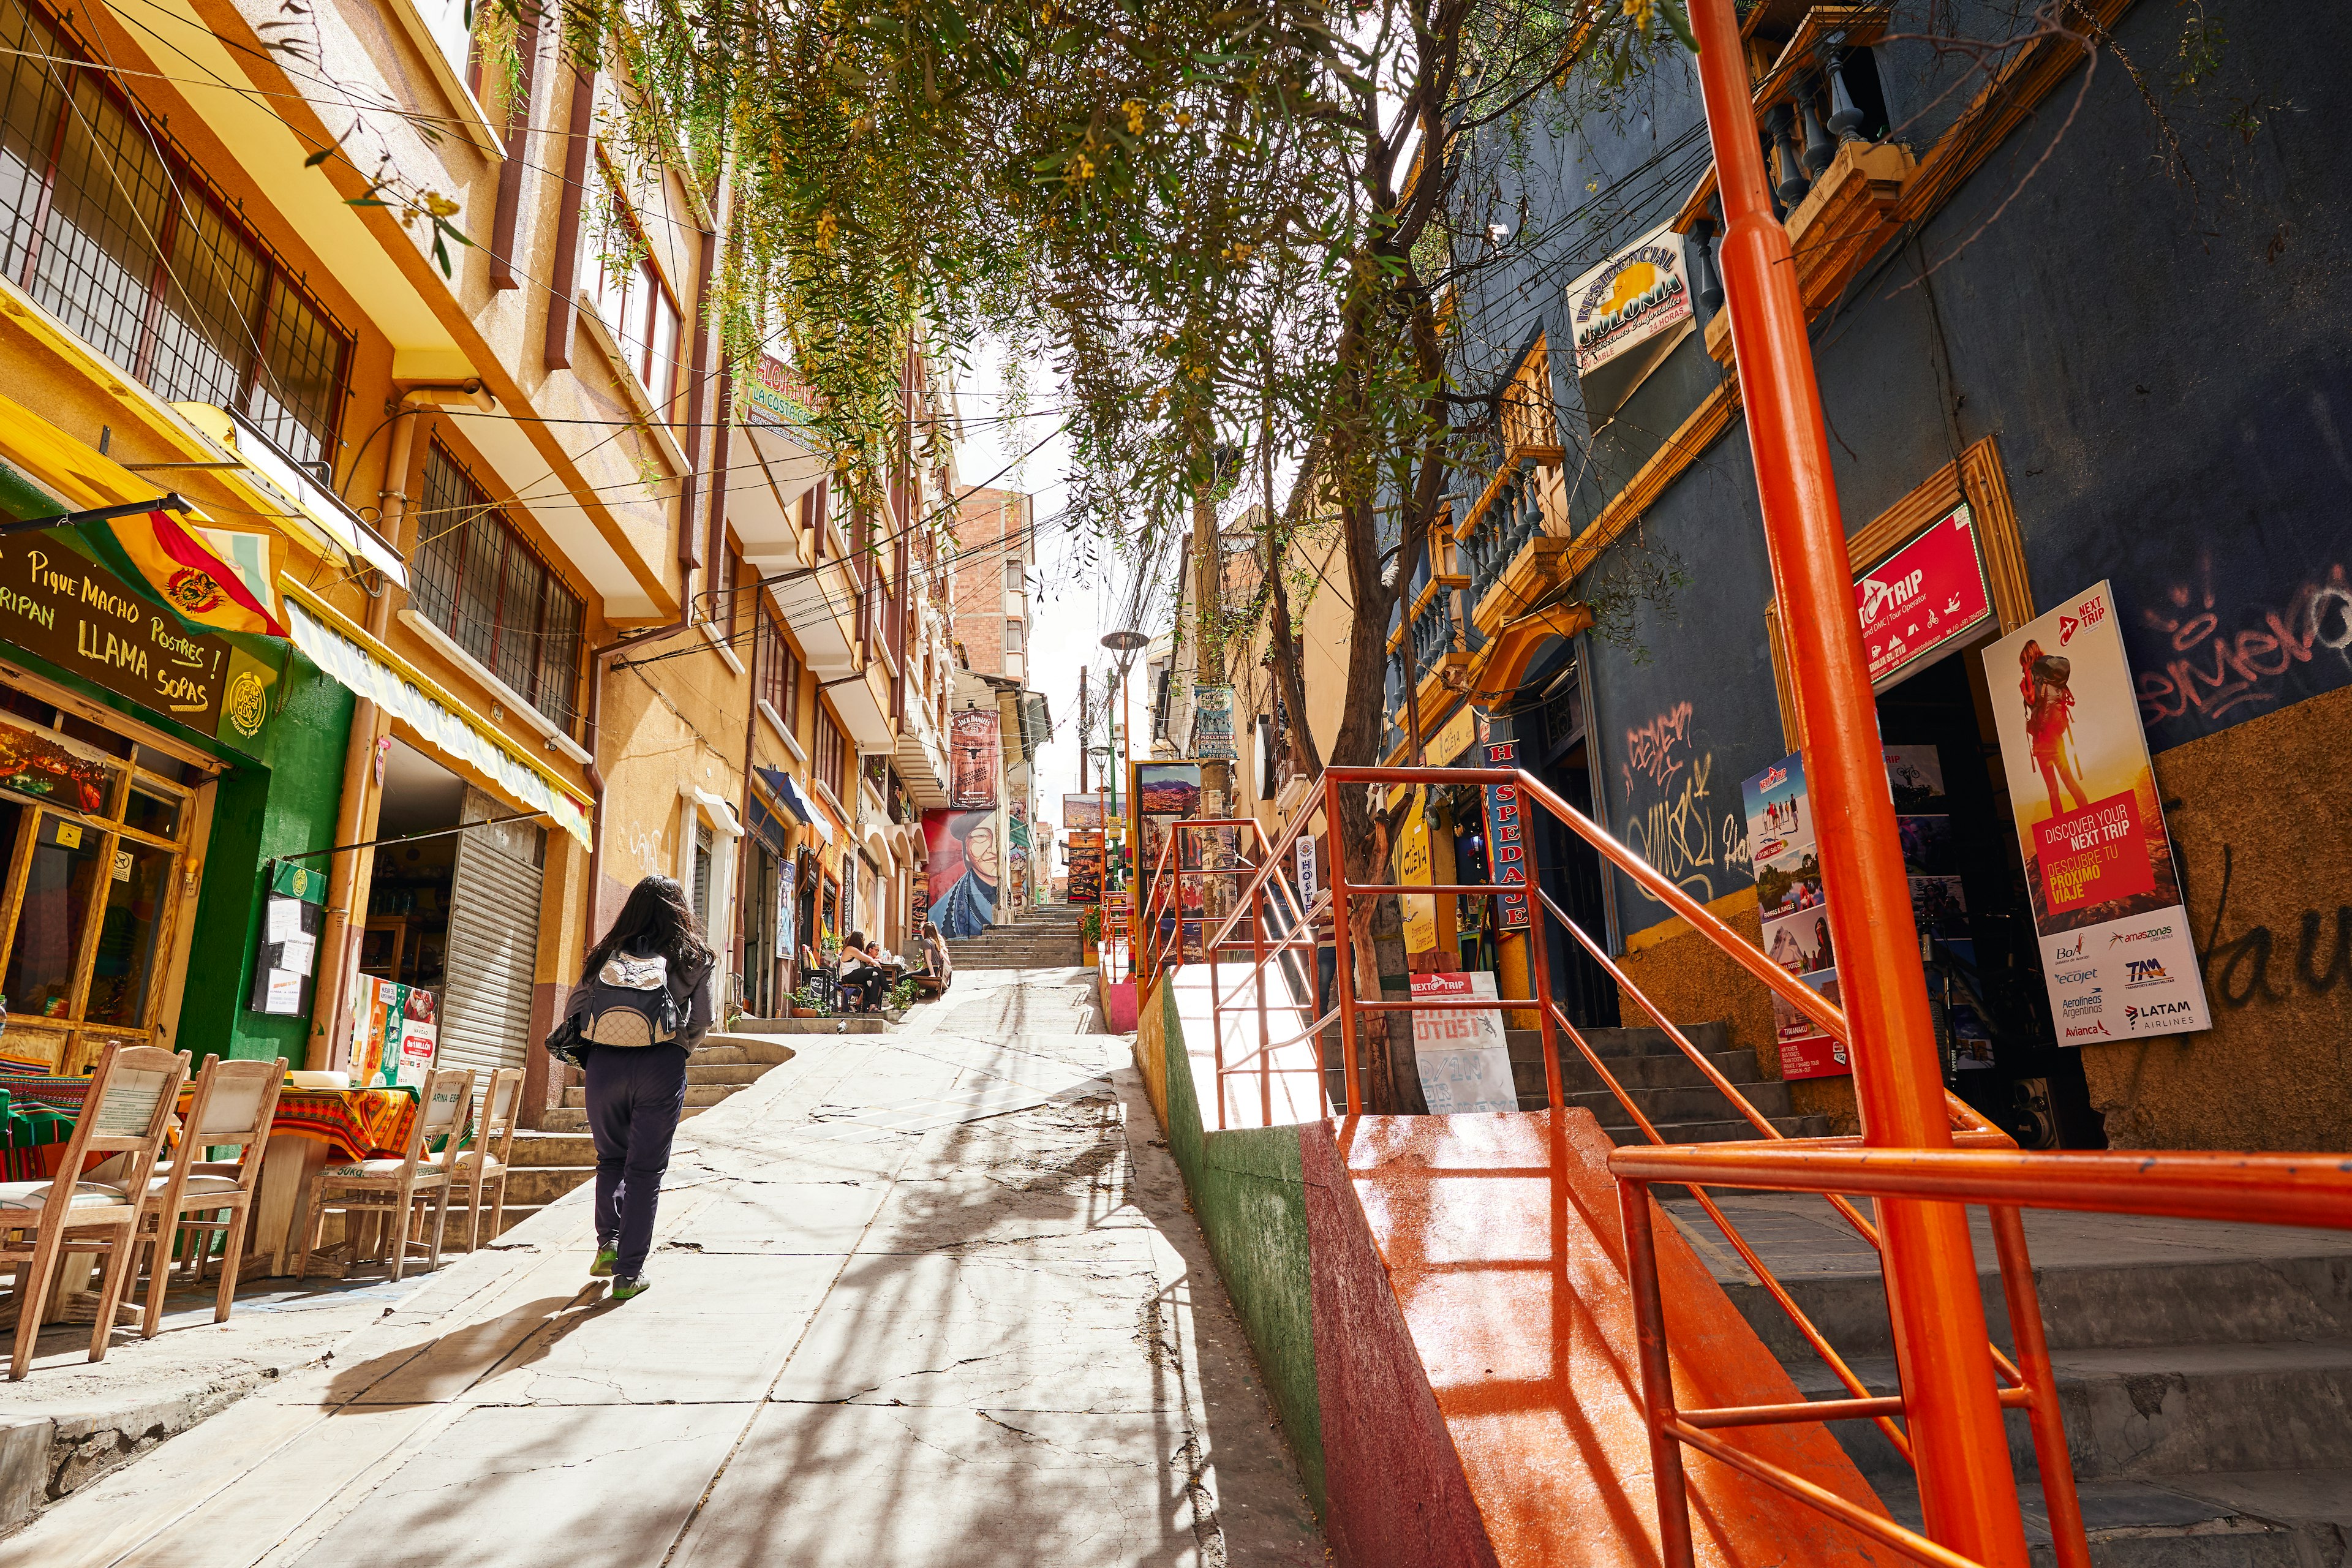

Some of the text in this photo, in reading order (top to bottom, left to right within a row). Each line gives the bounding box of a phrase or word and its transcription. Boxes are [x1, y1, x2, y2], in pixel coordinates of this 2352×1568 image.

[1577, 246, 1676, 322] RESIDENCIAL
[1579, 274, 1682, 347] COLONIA
[1649, 307, 1684, 333] 24 HORAS
[1593, 347, 1615, 365] CABLE
[753, 384, 796, 421] LA COSTA
[766, 410, 780, 423] HORAS
[81, 576, 140, 624] MACHO
[1884, 568, 1923, 611] TRIP
[1874, 593, 1927, 632] DMC Tour Operator
[2079, 595, 2101, 617] NEXT
[2081, 607, 2105, 628] TRIP
[77, 619, 148, 681] LLAMA
[151, 616, 205, 668] POSTRES
[1868, 657, 1887, 673] TARIJA
[1895, 643, 1906, 658] 210
[154, 669, 209, 712] SOPAS
[230, 715, 258, 739] bolivian food
[957, 717, 971, 727] JACK
[1444, 730, 1460, 753] CUEVA
[1759, 767, 1787, 790] NEXT TRIP
[1489, 744, 1529, 925] HSPEDAJE
[2045, 804, 2128, 844] DISCOVER YOUR
[2070, 820, 2130, 851] NEXT TRIP
[1404, 845, 1427, 876] CUEVA
[1758, 849, 1769, 859] UYUNI
[2048, 844, 2119, 878] DESCUBRE TU
[2049, 864, 2101, 891] PROXIMO
[2052, 883, 2085, 905] VIAJE
[1763, 909, 1777, 919] PAMPAS
[1781, 902, 1795, 913] JUNGLE
[2125, 926, 2172, 943] amaszonas
[2057, 944, 2081, 960] BoA
[2059, 968, 2098, 984] ecojet
[2125, 958, 2166, 982] TAM
[1411, 981, 1464, 991] NEXT TRIP
[2063, 995, 2101, 1009] Aerolíneas
[2063, 1005, 2103, 1019] Argentinas
[2141, 1001, 2191, 1017] LATAM
[1413, 1018, 1480, 1041] OTOSI
[1784, 1025, 1807, 1036] TIWANAKU
[2066, 1026, 2098, 1038] Avianca
[2144, 1016, 2194, 1029] AIRLINES
[1836, 1053, 1845, 1061] VISA
